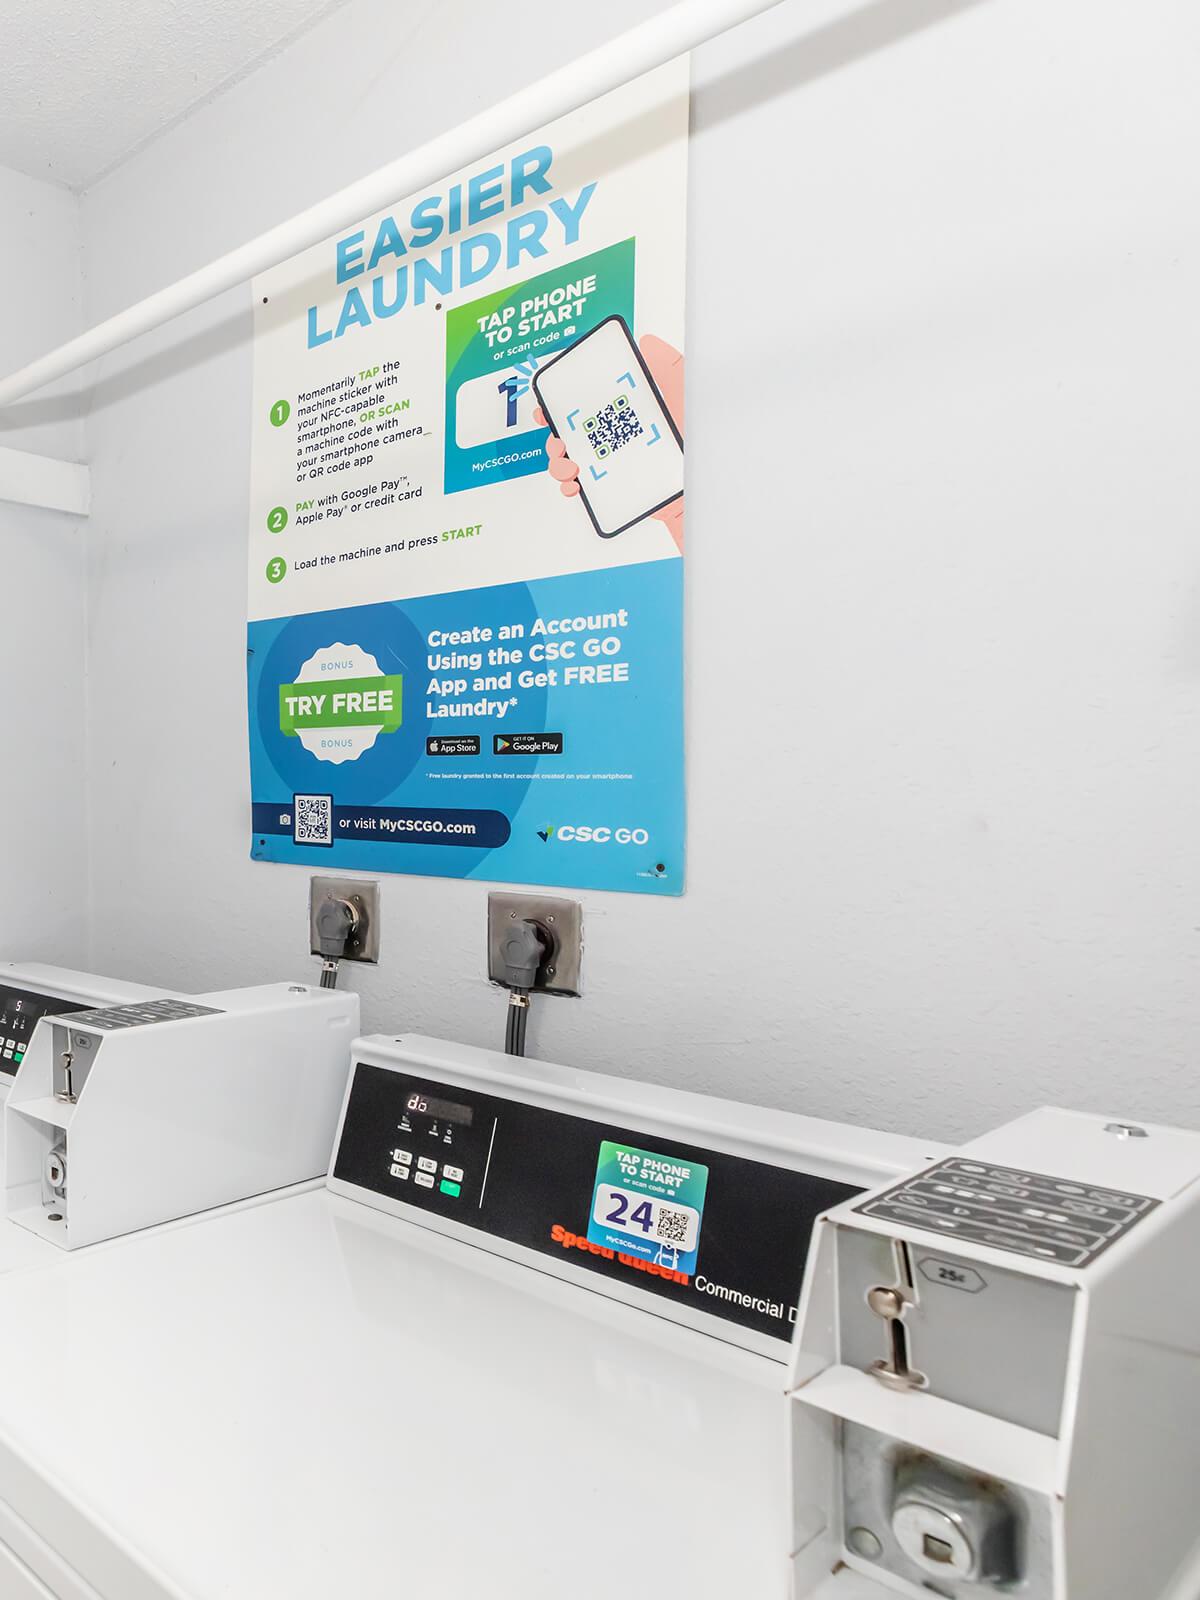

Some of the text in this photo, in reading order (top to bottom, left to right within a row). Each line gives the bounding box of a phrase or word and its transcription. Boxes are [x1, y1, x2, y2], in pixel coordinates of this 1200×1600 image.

[336, 145, 554, 285] EASIER
[307, 181, 599, 349] LAUNDRY
[477, 274, 597, 332] TAP PHONE
[485, 298, 587, 348] TO START
[493, 329, 560, 361] or scan code
[297, 375, 398, 417] machine sticker with
[298, 360, 400, 403] Momentarily TAP the
[276, 406, 284, 421] 1
[297, 394, 385, 432] your NFC-capable
[498, 376, 518, 427] 1
[297, 399, 410, 443] smartphone, OR SCAN
[297, 417, 399, 457] a machine code with
[296, 455, 317, 471] your
[320, 439, 380, 466] smartphone
[296, 455, 373, 482] or QR code app
[472, 447, 542, 472] MyCSCGO.com
[296, 500, 315, 513] PAY
[317, 493, 338, 507] with
[341, 483, 378, 502] Google
[296, 511, 324, 526] Apple
[350, 502, 362, 513] or
[364, 494, 395, 510] credit
[398, 487, 423, 502] card
[272, 513, 282, 529] 2
[294, 524, 482, 571] Load the machine and press START
[271, 563, 281, 578] 3
[427, 608, 628, 648] Create an Account
[321, 661, 353, 671] BONUS
[427, 636, 621, 671] Using the CSC GO
[426, 662, 629, 697] App and Get FREE
[285, 689, 394, 716] TRY FREE
[321, 739, 353, 748] BONUS
[440, 743, 477, 753] App Store
[512, 741, 559, 753] Google Play
[339, 817, 476, 834] or visit MyCSCGO.com
[557, 826, 649, 844] CSC GO
[616, 1151, 691, 1179] TAP PHONE
[620, 1163, 683, 1188] TO START
[632, 1180, 647, 1188] scan
[648, 1184, 665, 1193] code
[606, 1192, 654, 1233] 24
[695, 1275, 783, 1319] Commercial
